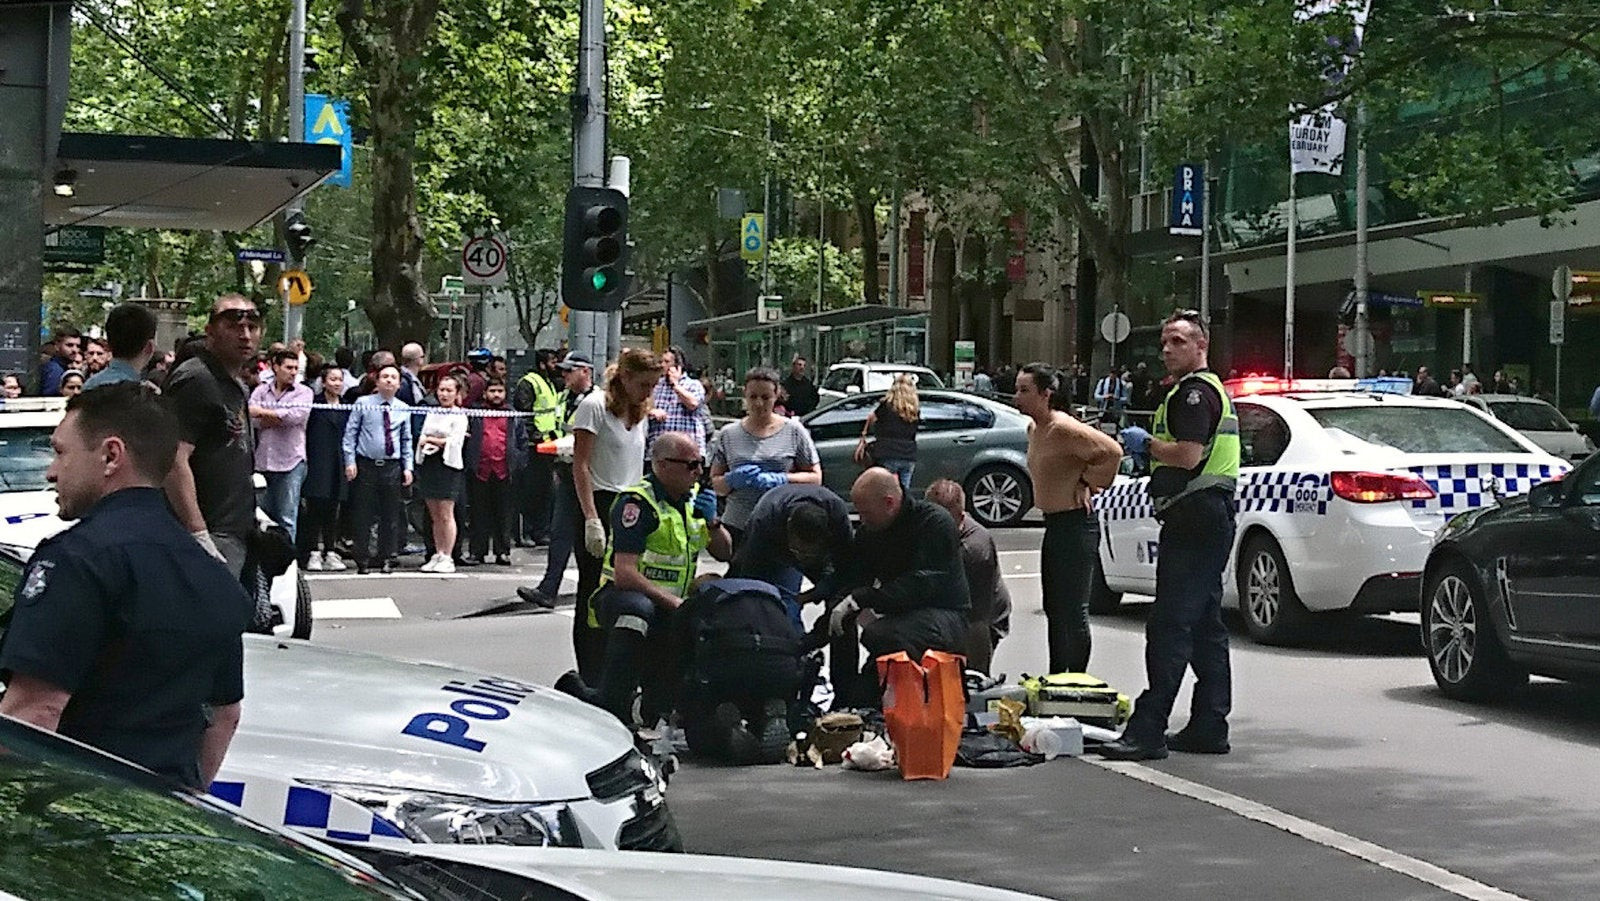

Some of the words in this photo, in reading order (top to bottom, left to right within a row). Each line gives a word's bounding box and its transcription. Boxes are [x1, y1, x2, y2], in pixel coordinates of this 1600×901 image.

[1181, 166, 1194, 227] DRAMA
[468, 247, 500, 268] 40
[1295, 488, 1318, 502] 000
[644, 567, 679, 581] HEALTH
